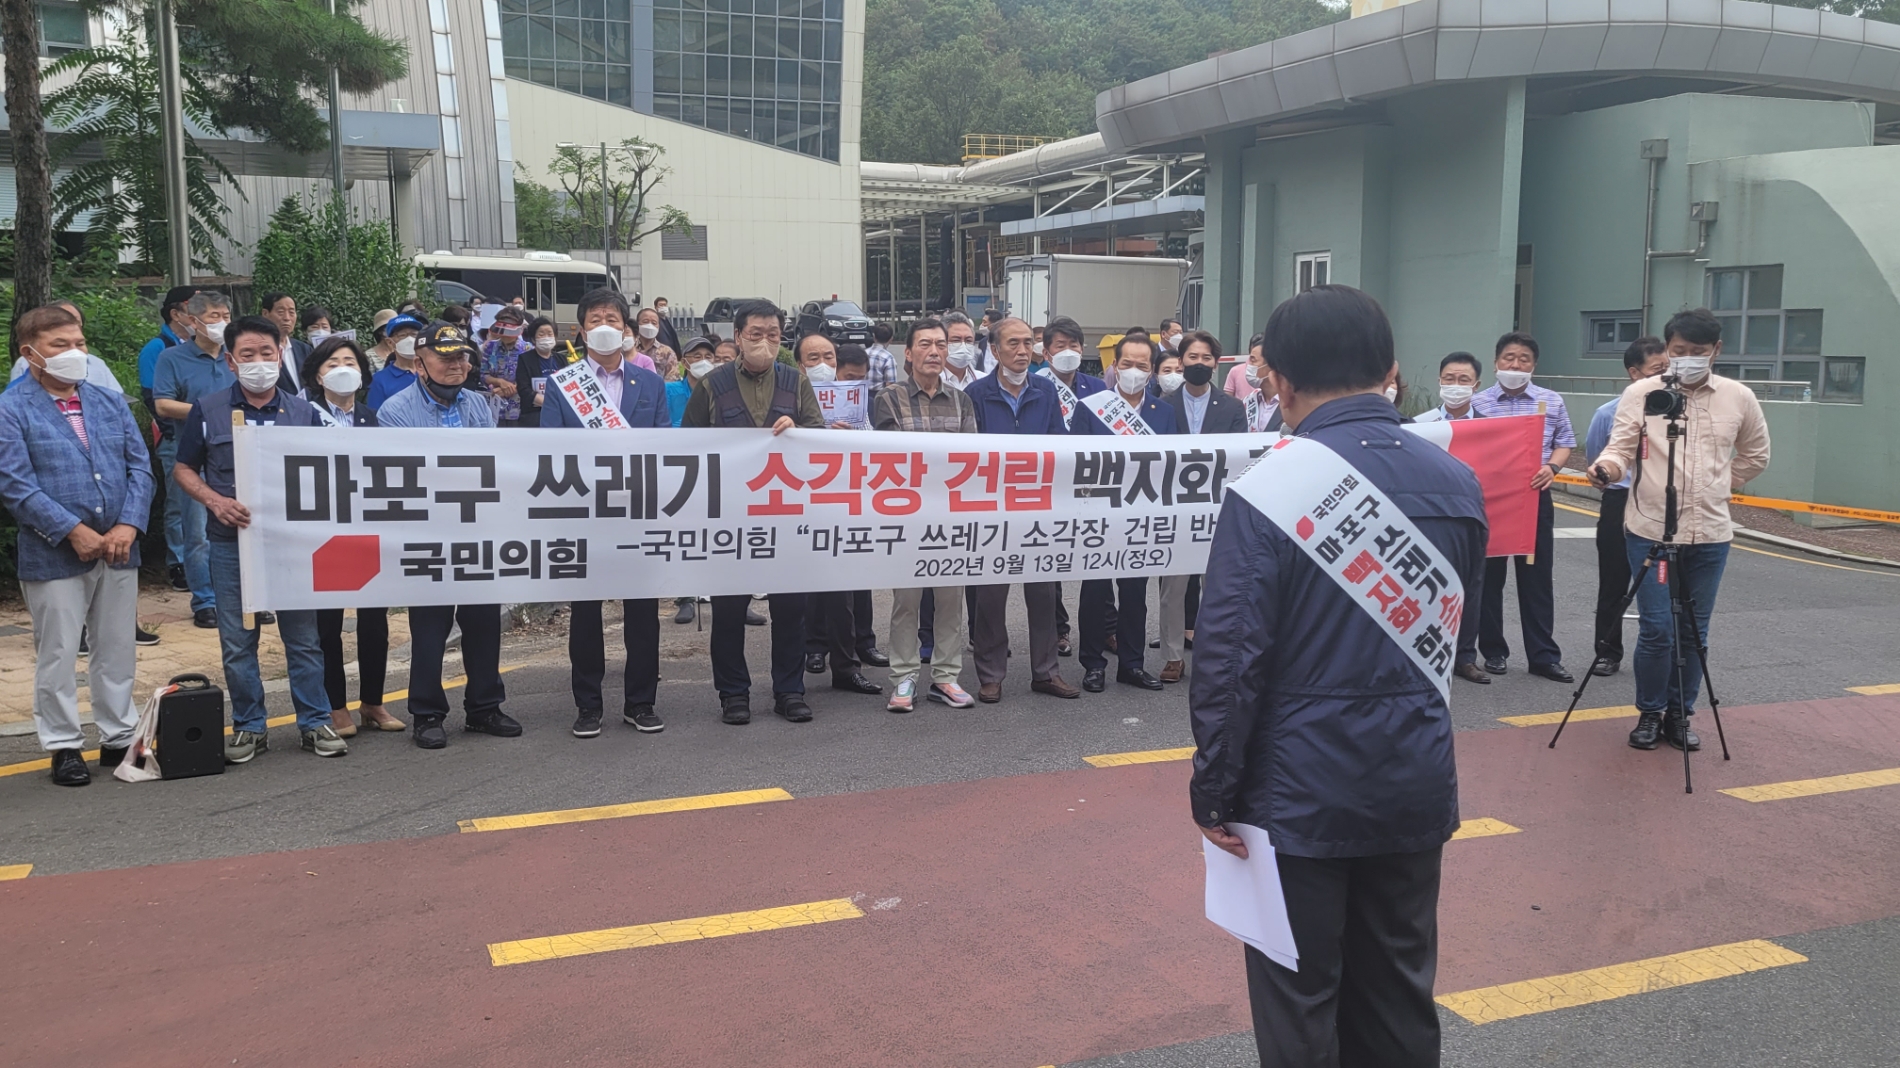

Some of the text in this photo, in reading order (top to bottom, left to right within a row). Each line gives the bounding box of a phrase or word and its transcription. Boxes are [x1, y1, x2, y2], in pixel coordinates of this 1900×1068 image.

[563, 381, 594, 417] 백지화
[578, 374, 608, 408] 쓰레기
[601, 407, 627, 428] 소각
[284, 454, 500, 523] 마포구
[527, 453, 721, 519] 쓰레기
[746, 451, 928, 516] 소각장
[944, 451, 1055, 512] 건립
[1073, 448, 1228, 508] 백지화
[1312, 473, 1360, 520] 국민의힘
[917, 520, 1008, 553] 쓰레기
[1021, 518, 1109, 548] 소각장
[1124, 515, 1177, 545] 건립
[1314, 494, 1382, 564] 마포구
[400, 537, 588, 582] 국민의힘
[914, 547, 1173, 578] 2022년 9월 13일 12시(정오)
[1373, 524, 1449, 605] 쓰레기
[1341, 549, 1423, 634] 백지화
